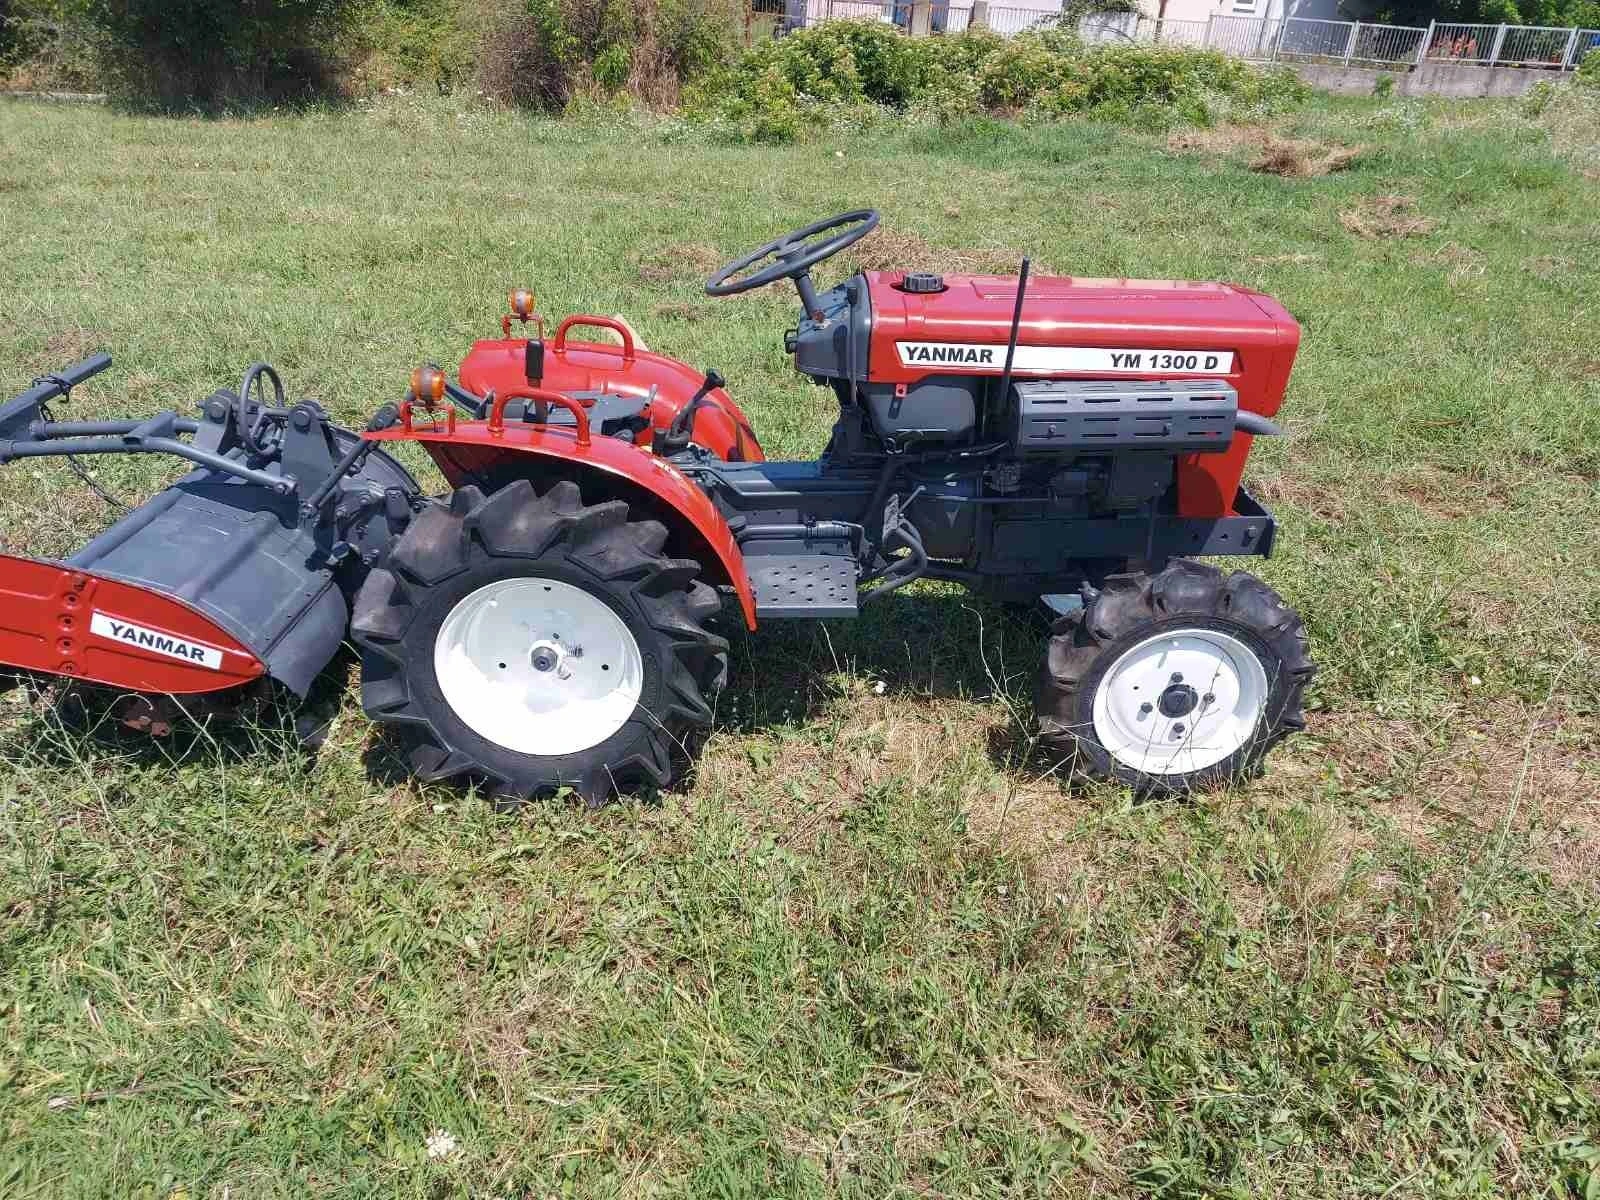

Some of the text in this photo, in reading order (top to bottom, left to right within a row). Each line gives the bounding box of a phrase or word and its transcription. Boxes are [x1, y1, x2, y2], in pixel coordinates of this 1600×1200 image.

[905, 346, 1219, 371] YANMAR YM 1300 D
[110, 621, 205, 662] YANMAR
